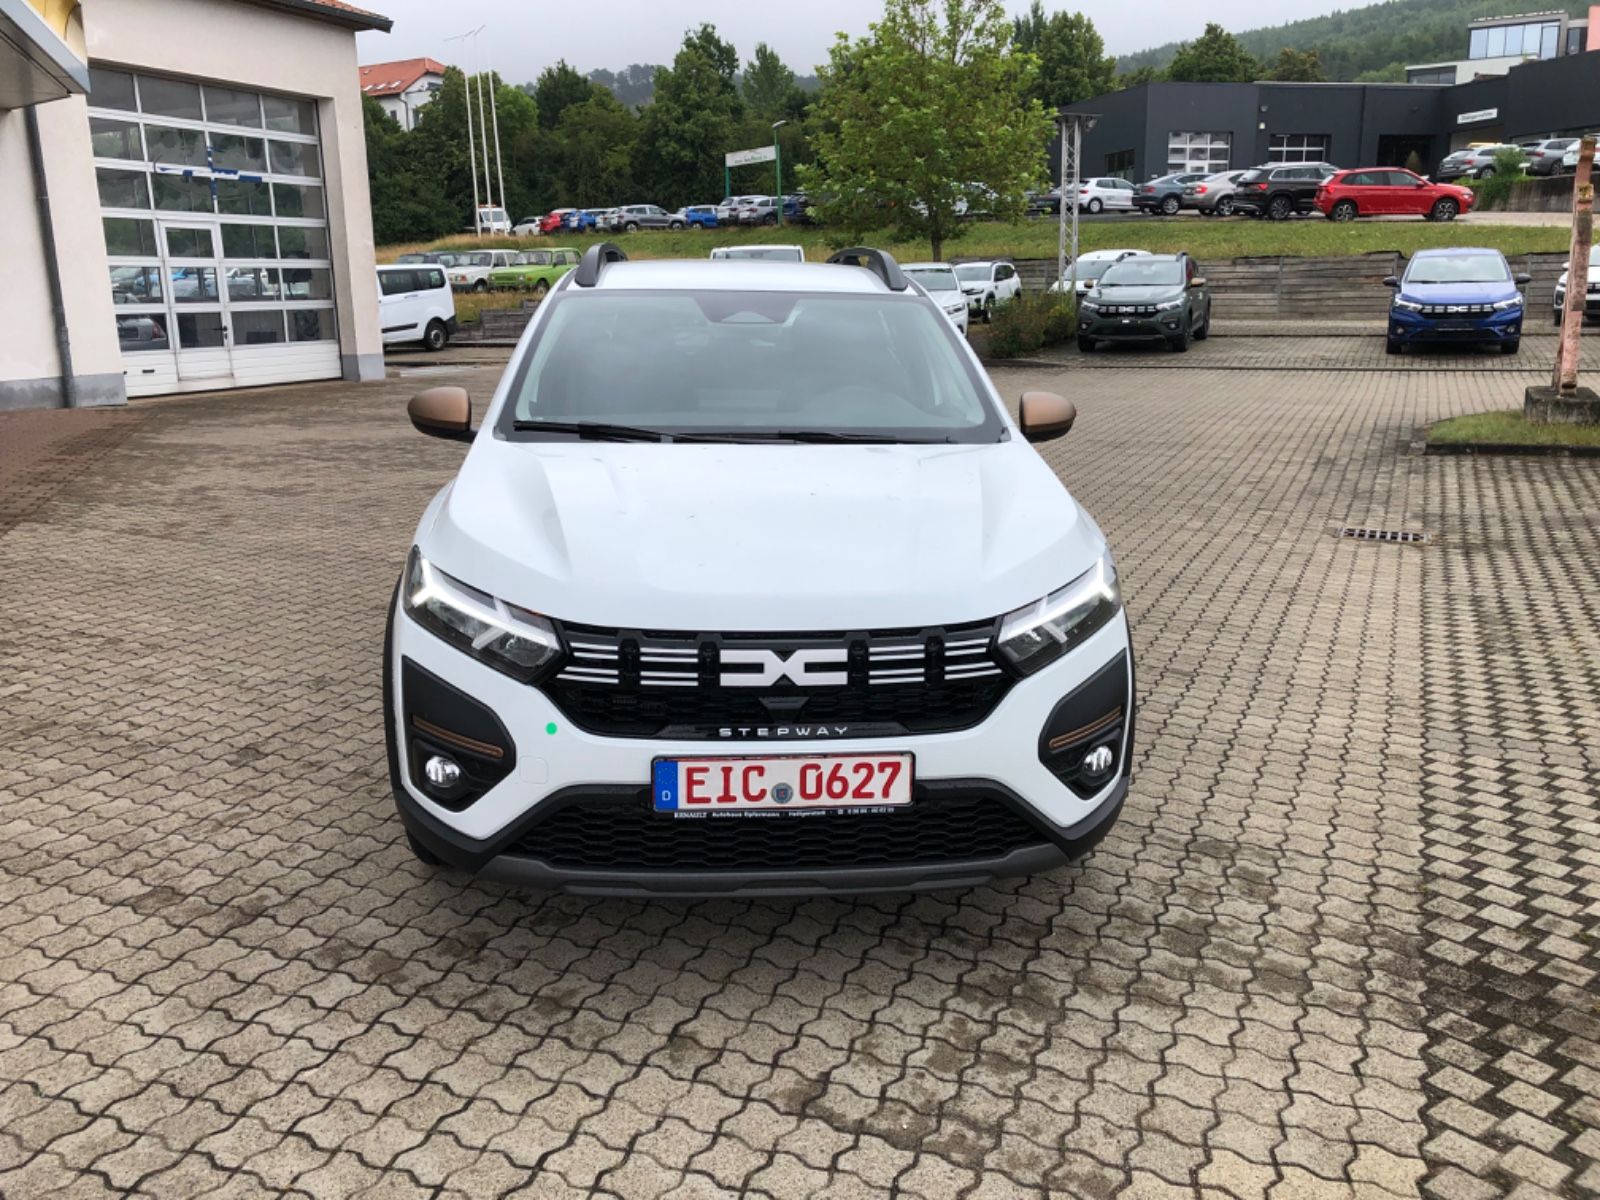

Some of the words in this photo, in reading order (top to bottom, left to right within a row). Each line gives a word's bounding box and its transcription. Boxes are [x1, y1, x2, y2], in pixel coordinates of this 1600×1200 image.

[718, 726, 849, 737] STEPWAY
[685, 765, 768, 804] EIC
[799, 761, 902, 800] 0627
[661, 789, 671, 801] D
